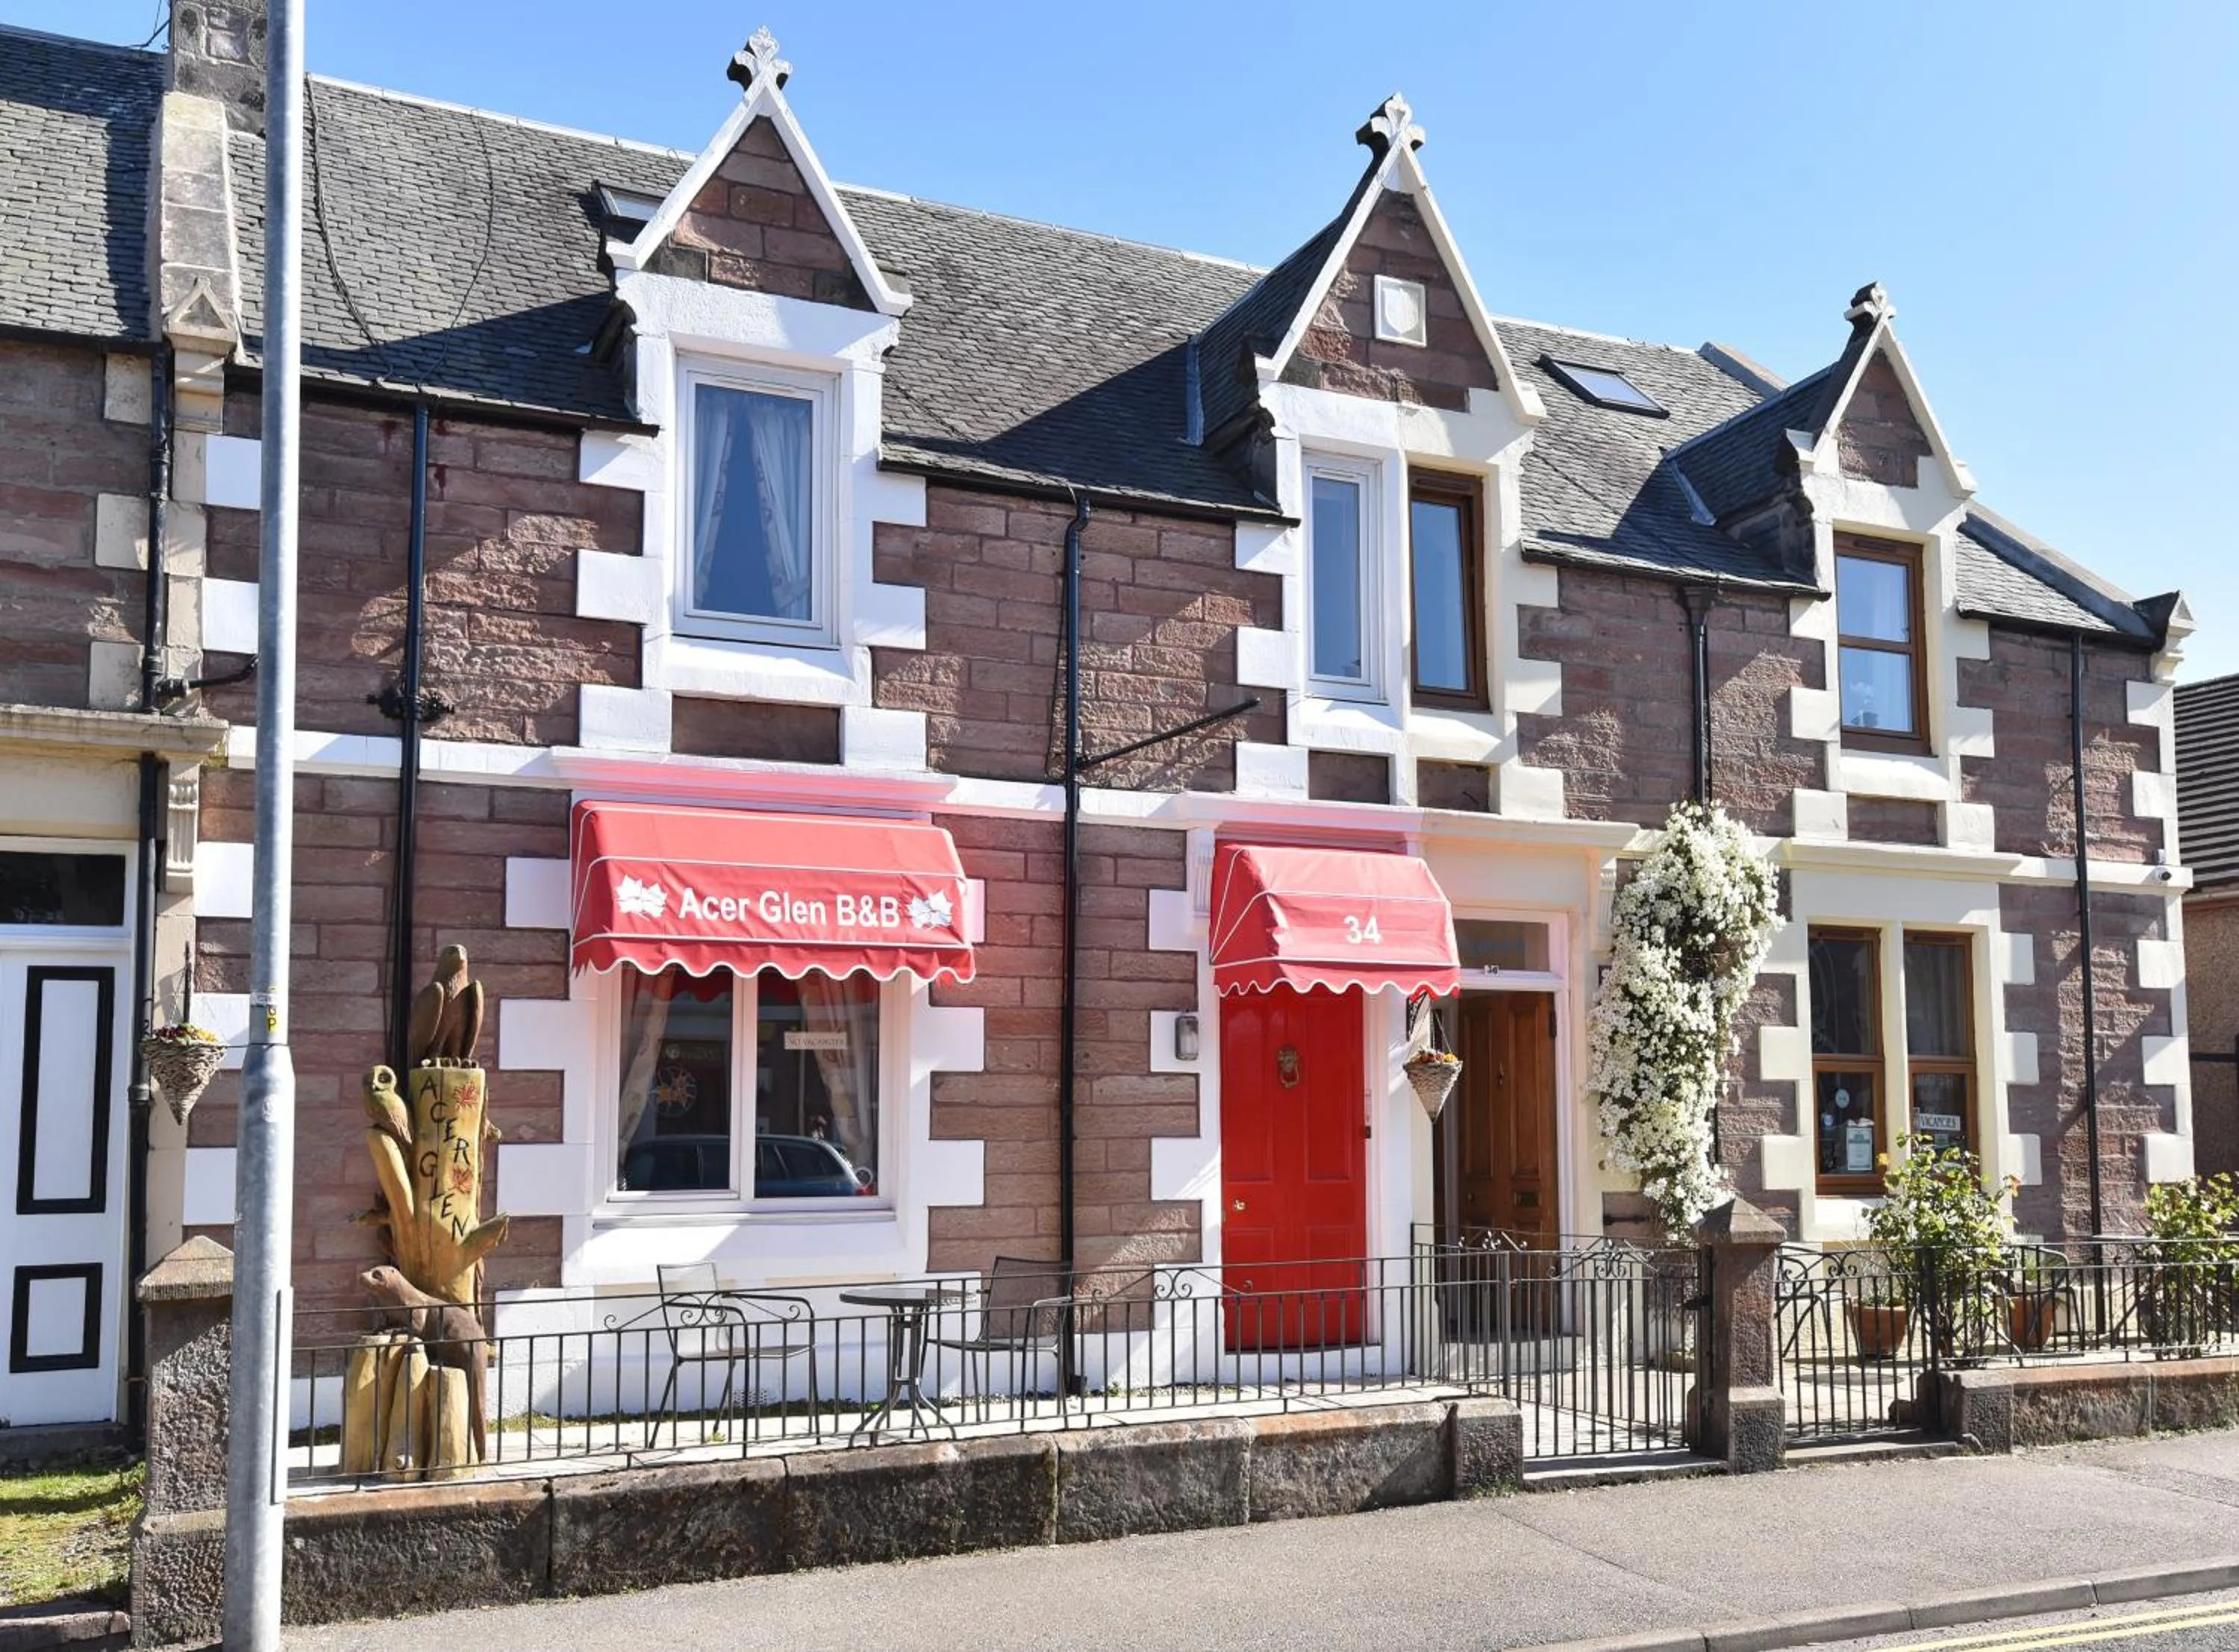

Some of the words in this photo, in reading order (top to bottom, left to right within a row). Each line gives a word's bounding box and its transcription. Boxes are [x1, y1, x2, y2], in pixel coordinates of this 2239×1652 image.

[678, 887, 750, 921] Acer
[758, 891, 827, 926] Glen
[836, 895, 901, 927] B&B
[1343, 915, 1383, 945] 34
[419, 1076, 471, 1166] ACER
[419, 1151, 470, 1242] GLEN
